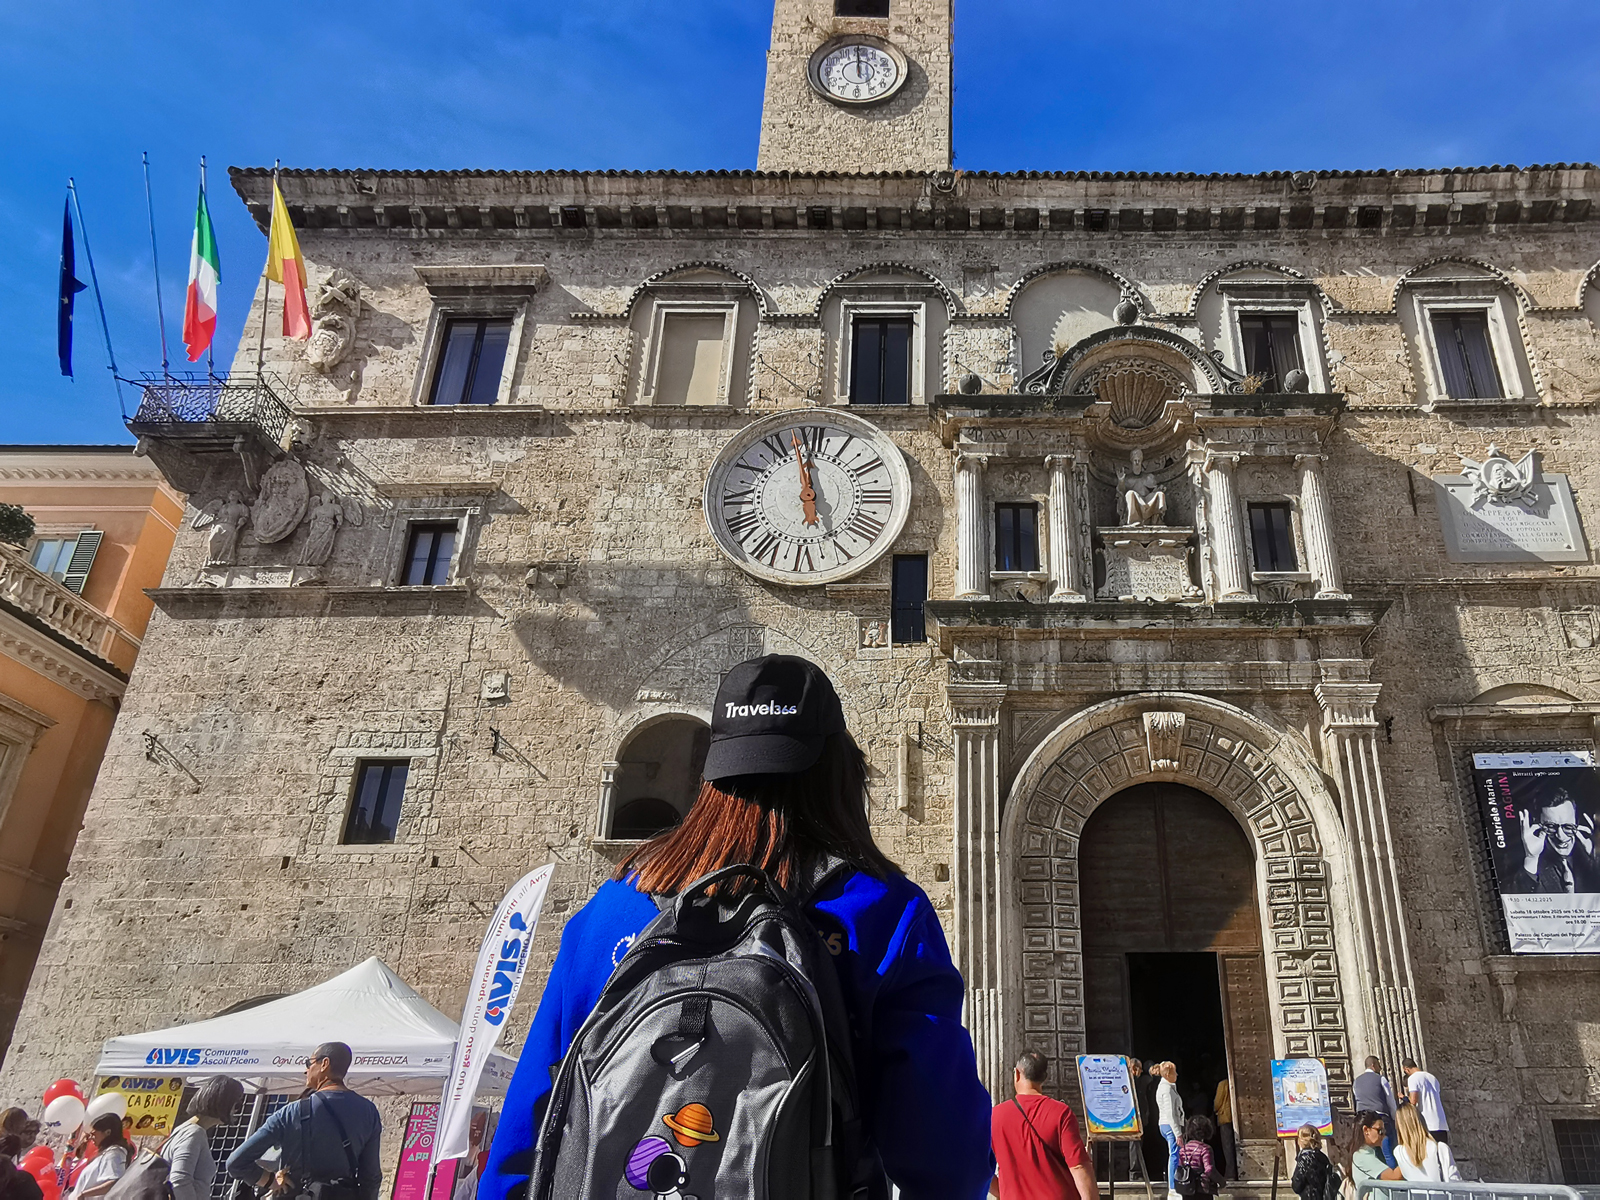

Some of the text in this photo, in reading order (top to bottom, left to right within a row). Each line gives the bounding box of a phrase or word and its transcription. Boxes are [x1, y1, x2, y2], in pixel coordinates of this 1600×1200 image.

[725, 700, 798, 719] Travel365
[1484, 779, 1497, 805] Maria
[1497, 772, 1516, 819] PAGNINI
[1490, 806, 1506, 848] Gabriele
[484, 938, 521, 1027] AVIS
[508, 939, 530, 1011] ASCOLI PICENO
[456, 1071, 466, 1091] tuo
[462, 1037, 474, 1068] gesto
[469, 1005, 481, 1033] dona
[478, 953, 495, 1002] speranza
[145, 1048, 202, 1065] AVIS
[201, 1056, 260, 1065] Ascoli Piceno
[205, 1048, 249, 1057] Comunale
[272, 1055, 294, 1067] Ogni
[354, 1056, 409, 1065] DIFFERENZA
[121, 1077, 157, 1090] AVIS
